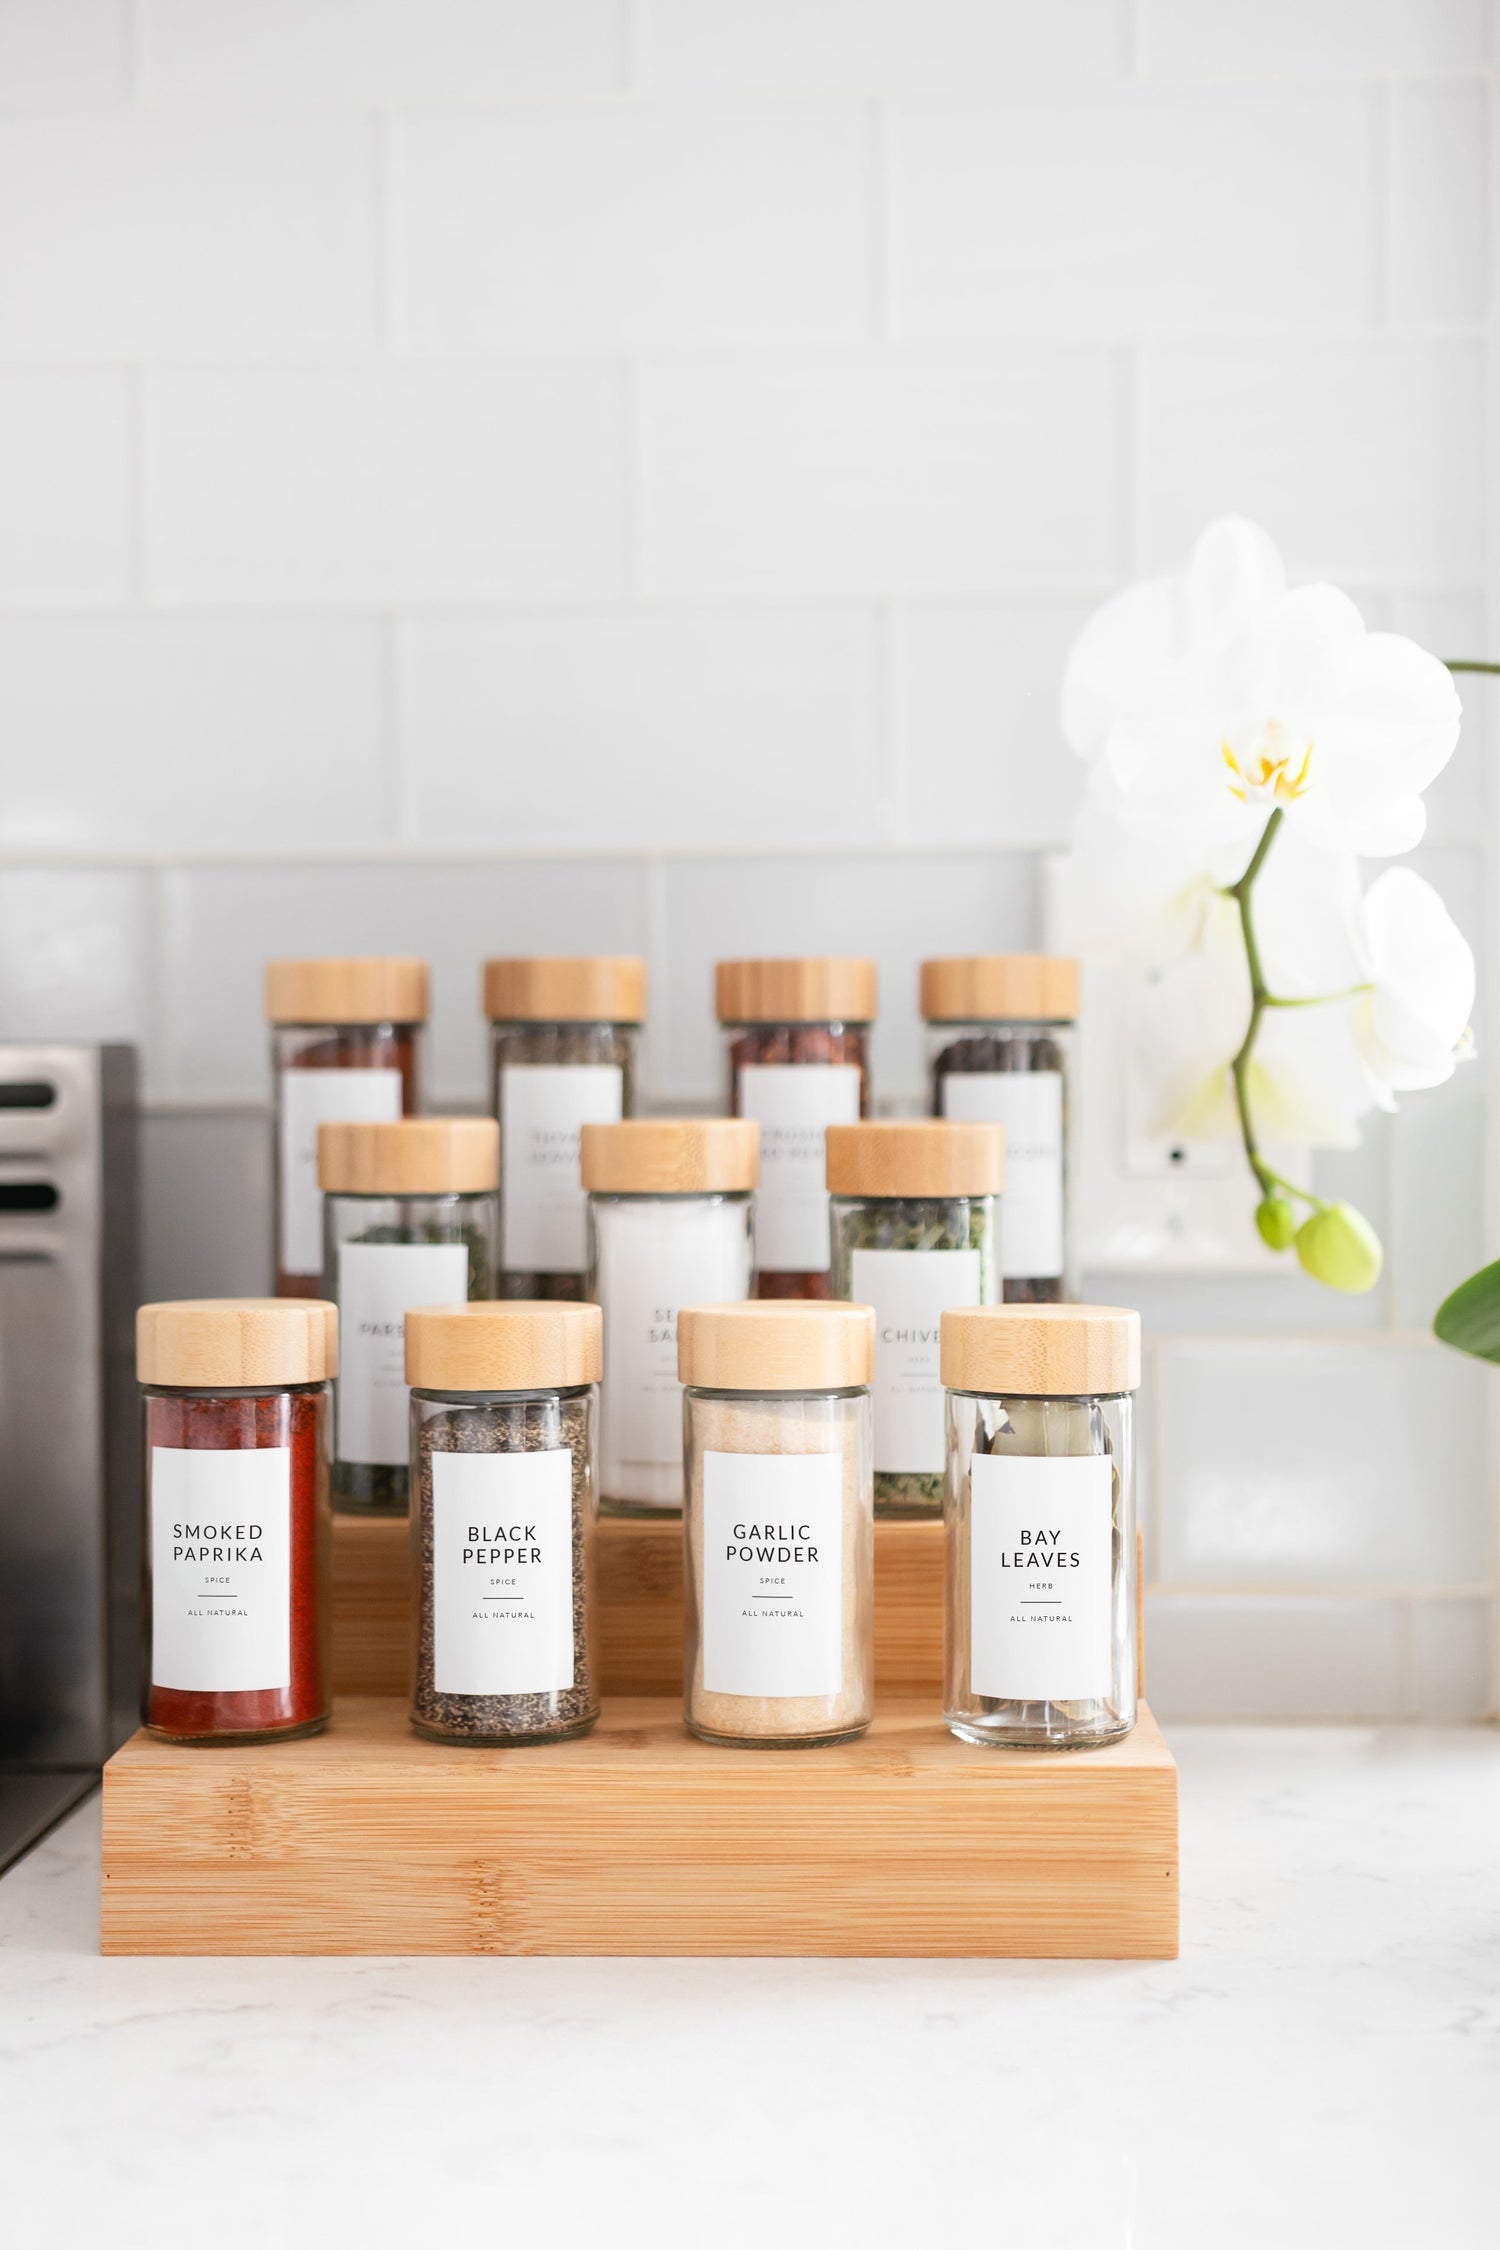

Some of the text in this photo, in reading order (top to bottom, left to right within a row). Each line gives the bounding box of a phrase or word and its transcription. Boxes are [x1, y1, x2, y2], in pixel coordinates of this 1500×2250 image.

[882, 1328, 941, 1344] CHIVE
[174, 1524, 263, 1540] SMOKED
[469, 1526, 537, 1542] BLACK
[734, 1524, 811, 1540] GARLIC
[1021, 1529, 1062, 1545] BAY
[173, 1546, 264, 1562] PAPRIKA
[463, 1548, 542, 1564] PEPPER
[727, 1546, 819, 1562] POWDER
[1001, 1551, 1080, 1567] LEAVES
[204, 1576, 231, 1584] SPICE
[490, 1578, 516, 1586] SPICE
[759, 1577, 786, 1585] SPICE
[1029, 1582, 1053, 1590] HERB
[187, 1609, 248, 1617] ALL NATURAL
[472, 1611, 535, 1619] ALL NATURAL
[742, 1609, 804, 1618] ALL NATURAL
[1010, 1615, 1073, 1623] ALL NATURAL
